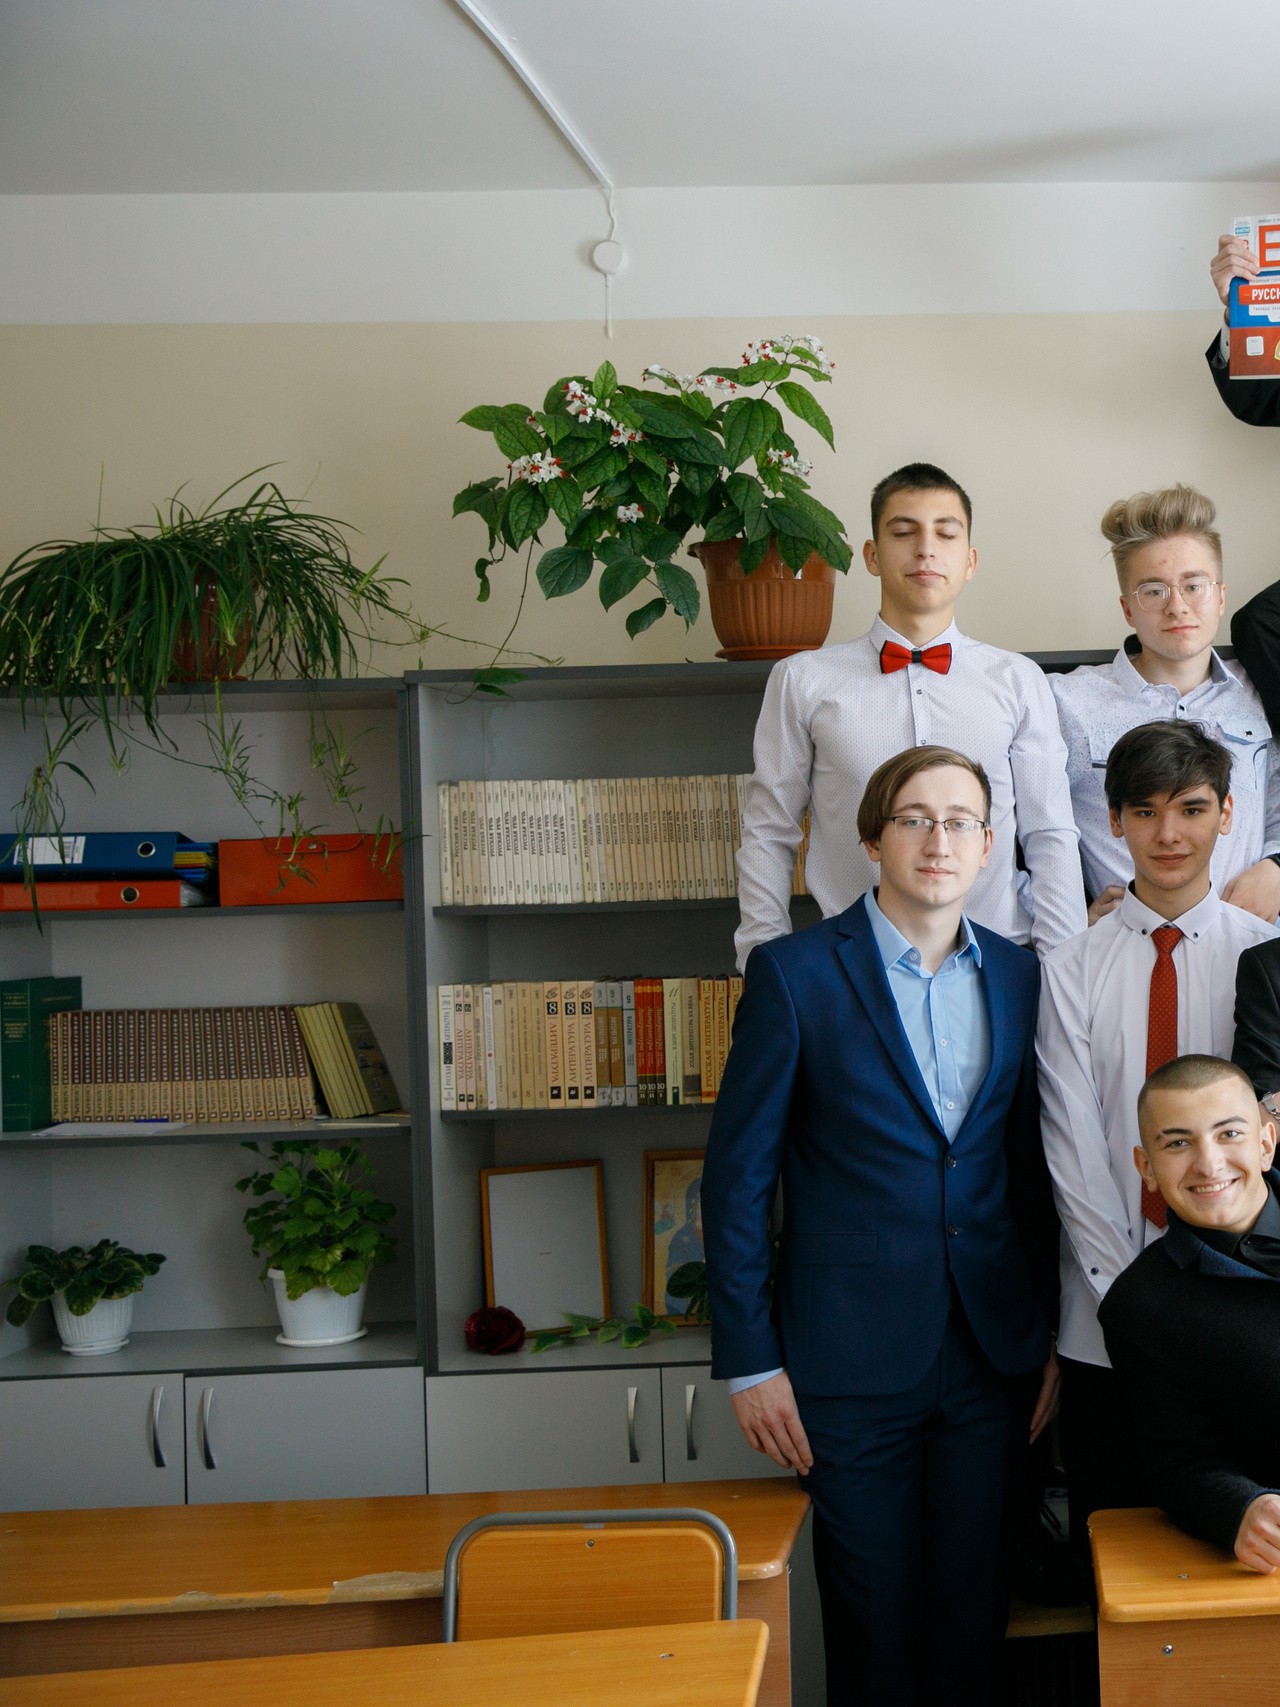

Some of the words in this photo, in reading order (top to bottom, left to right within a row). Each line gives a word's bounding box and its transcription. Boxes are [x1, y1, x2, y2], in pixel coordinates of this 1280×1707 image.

[598, 989, 602, 997] 9
[610, 989, 614, 998] 9
[627, 995, 631, 1003] 9
[549, 1002, 556, 1014] 8
[567, 1003, 575, 1014] 8
[583, 1002, 591, 1014] 8
[549, 1023, 560, 1082] ЛИТЕРАТУРА
[568, 1023, 576, 1082] ЛИТЕРАТУРА
[584, 1023, 592, 1082] ЛИТЕРАТУРА
